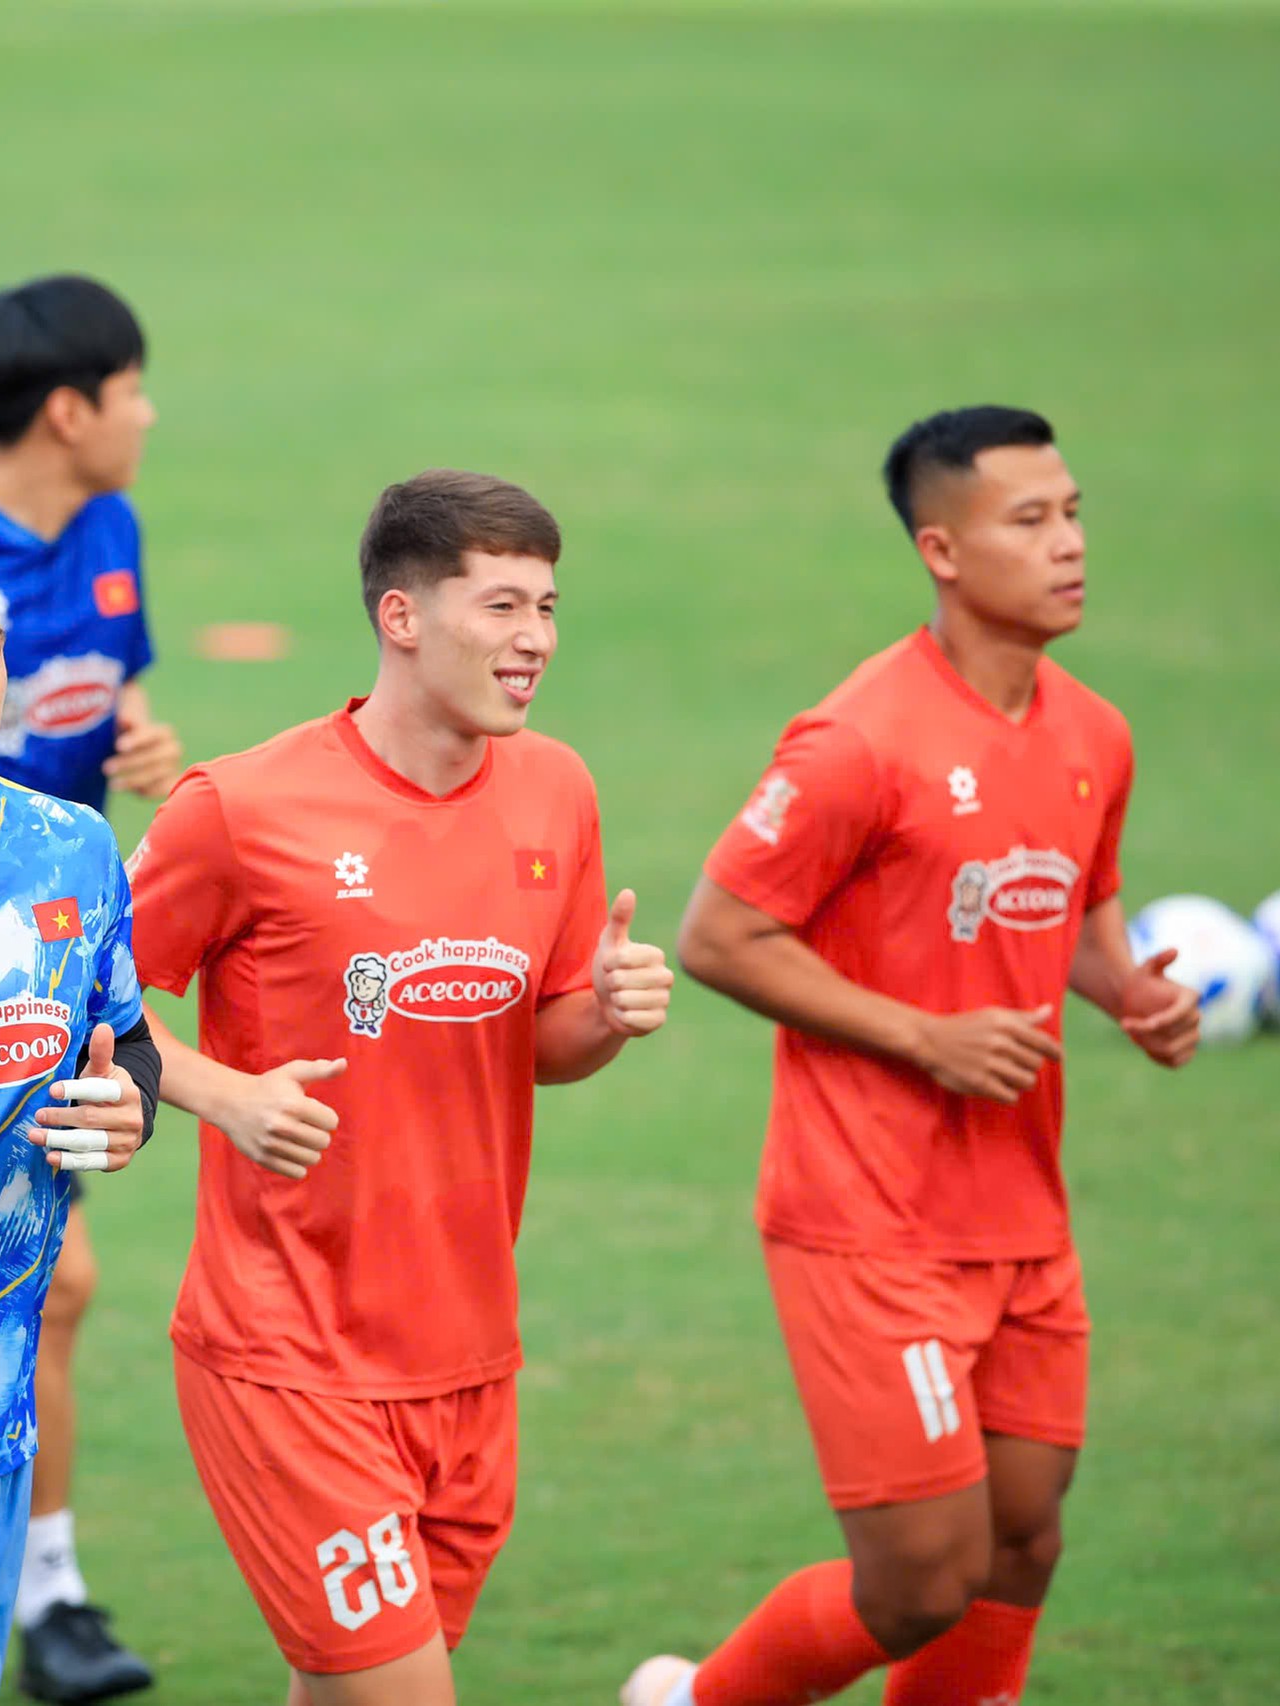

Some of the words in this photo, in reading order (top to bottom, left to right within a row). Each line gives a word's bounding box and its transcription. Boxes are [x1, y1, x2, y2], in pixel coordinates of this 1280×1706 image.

[390, 944, 436, 972] Cook
[442, 942, 527, 970] happiness
[902, 1337, 962, 1444] 11
[316, 1511, 419, 1632] 28
